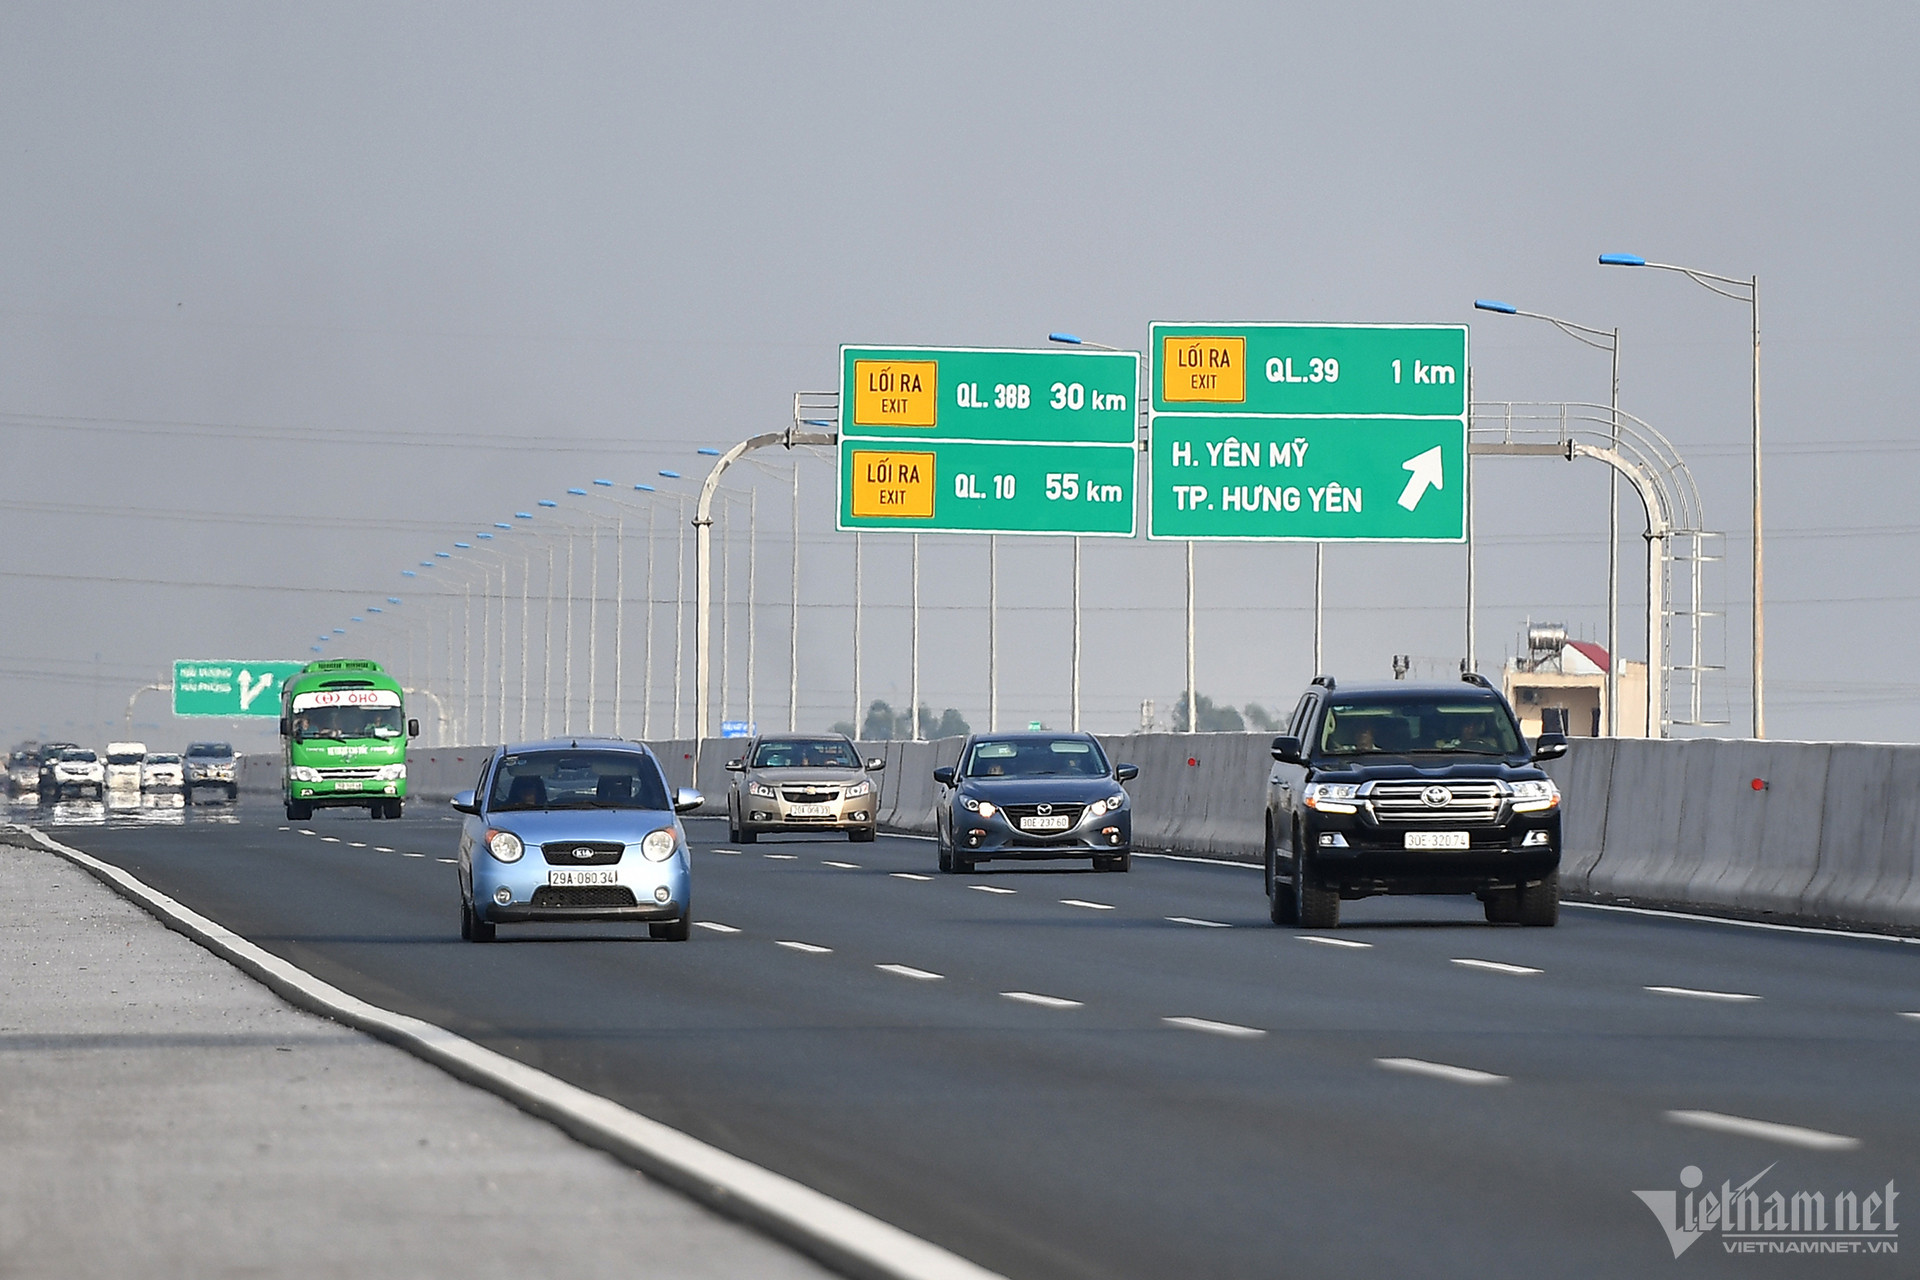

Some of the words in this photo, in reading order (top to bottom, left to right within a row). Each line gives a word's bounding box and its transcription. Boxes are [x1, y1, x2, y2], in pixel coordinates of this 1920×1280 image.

[1178, 343, 1203, 368] LỐI
[1209, 349, 1231, 368] RA
[869, 367, 895, 393] LỐI
[901, 373, 922, 393] RA
[1191, 374, 1217, 389] EXIT
[1265, 358, 1339, 384] QL.39
[1391, 359, 1402, 384] 1
[1413, 360, 1456, 385] km
[881, 399, 908, 414] EXIT
[956, 383, 988, 409] QL.
[994, 384, 1031, 409] 38B
[1049, 382, 1085, 410] 30
[1092, 389, 1126, 411] km
[1171, 442, 1199, 467] H.
[1205, 437, 1260, 467] YÊN
[1269, 438, 1309, 467] MỸ
[867, 457, 892, 483] LỐI
[899, 464, 920, 484] RA
[879, 490, 906, 505] EXIT
[954, 473, 987, 499] QL.
[993, 474, 1016, 500] 10
[1045, 473, 1080, 501] 55
[1086, 480, 1123, 502] km
[1172, 486, 1214, 511] TP.
[1222, 483, 1302, 512] HƯNG
[1307, 482, 1362, 513] YÊN
[575, 848, 593, 857] KIA
